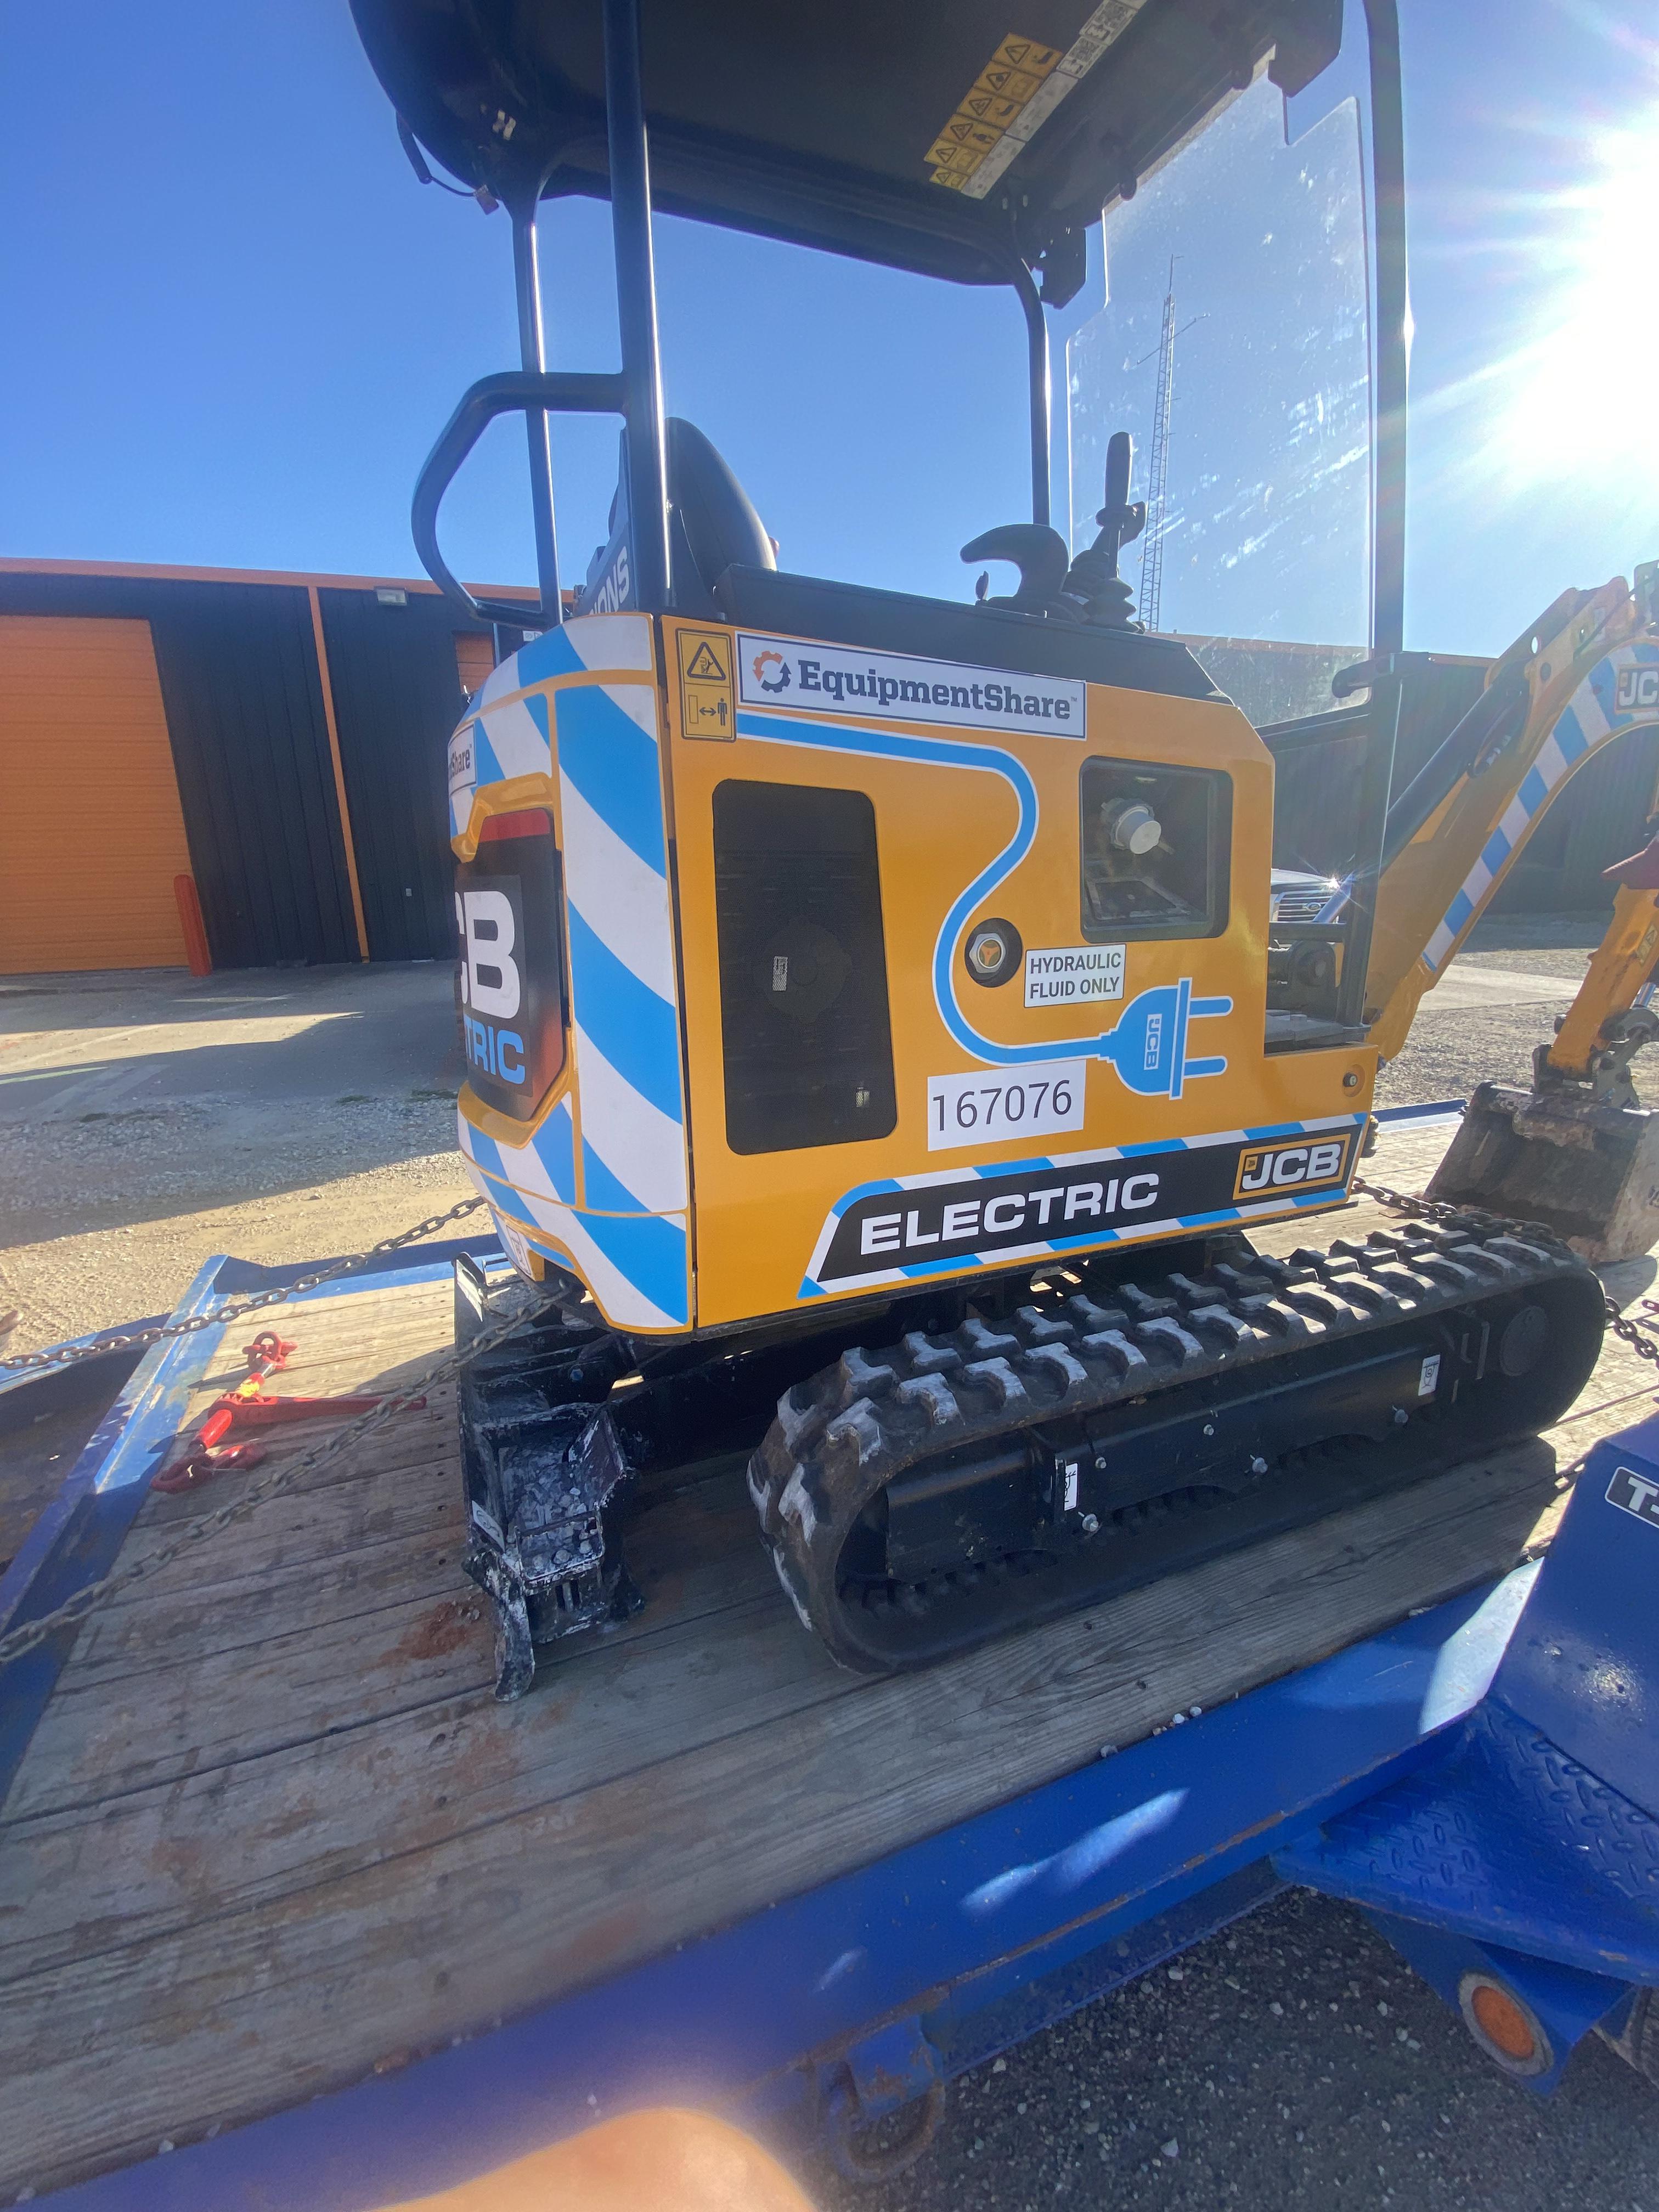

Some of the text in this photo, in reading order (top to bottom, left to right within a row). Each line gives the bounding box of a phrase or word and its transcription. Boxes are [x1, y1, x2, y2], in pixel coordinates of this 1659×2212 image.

[798, 659, 1070, 720] EquipmentShare
[1619, 671, 1659, 706] JC
[1030, 952, 1121, 974] HYDRAULIC
[1030, 977, 1120, 999] FLUID ONLY
[1146, 1018, 1160, 1068] JCB
[933, 1079, 1072, 1131] 167076
[1242, 1143, 1341, 1190] JCB
[860, 1173, 1159, 1255] ELECTRIC
